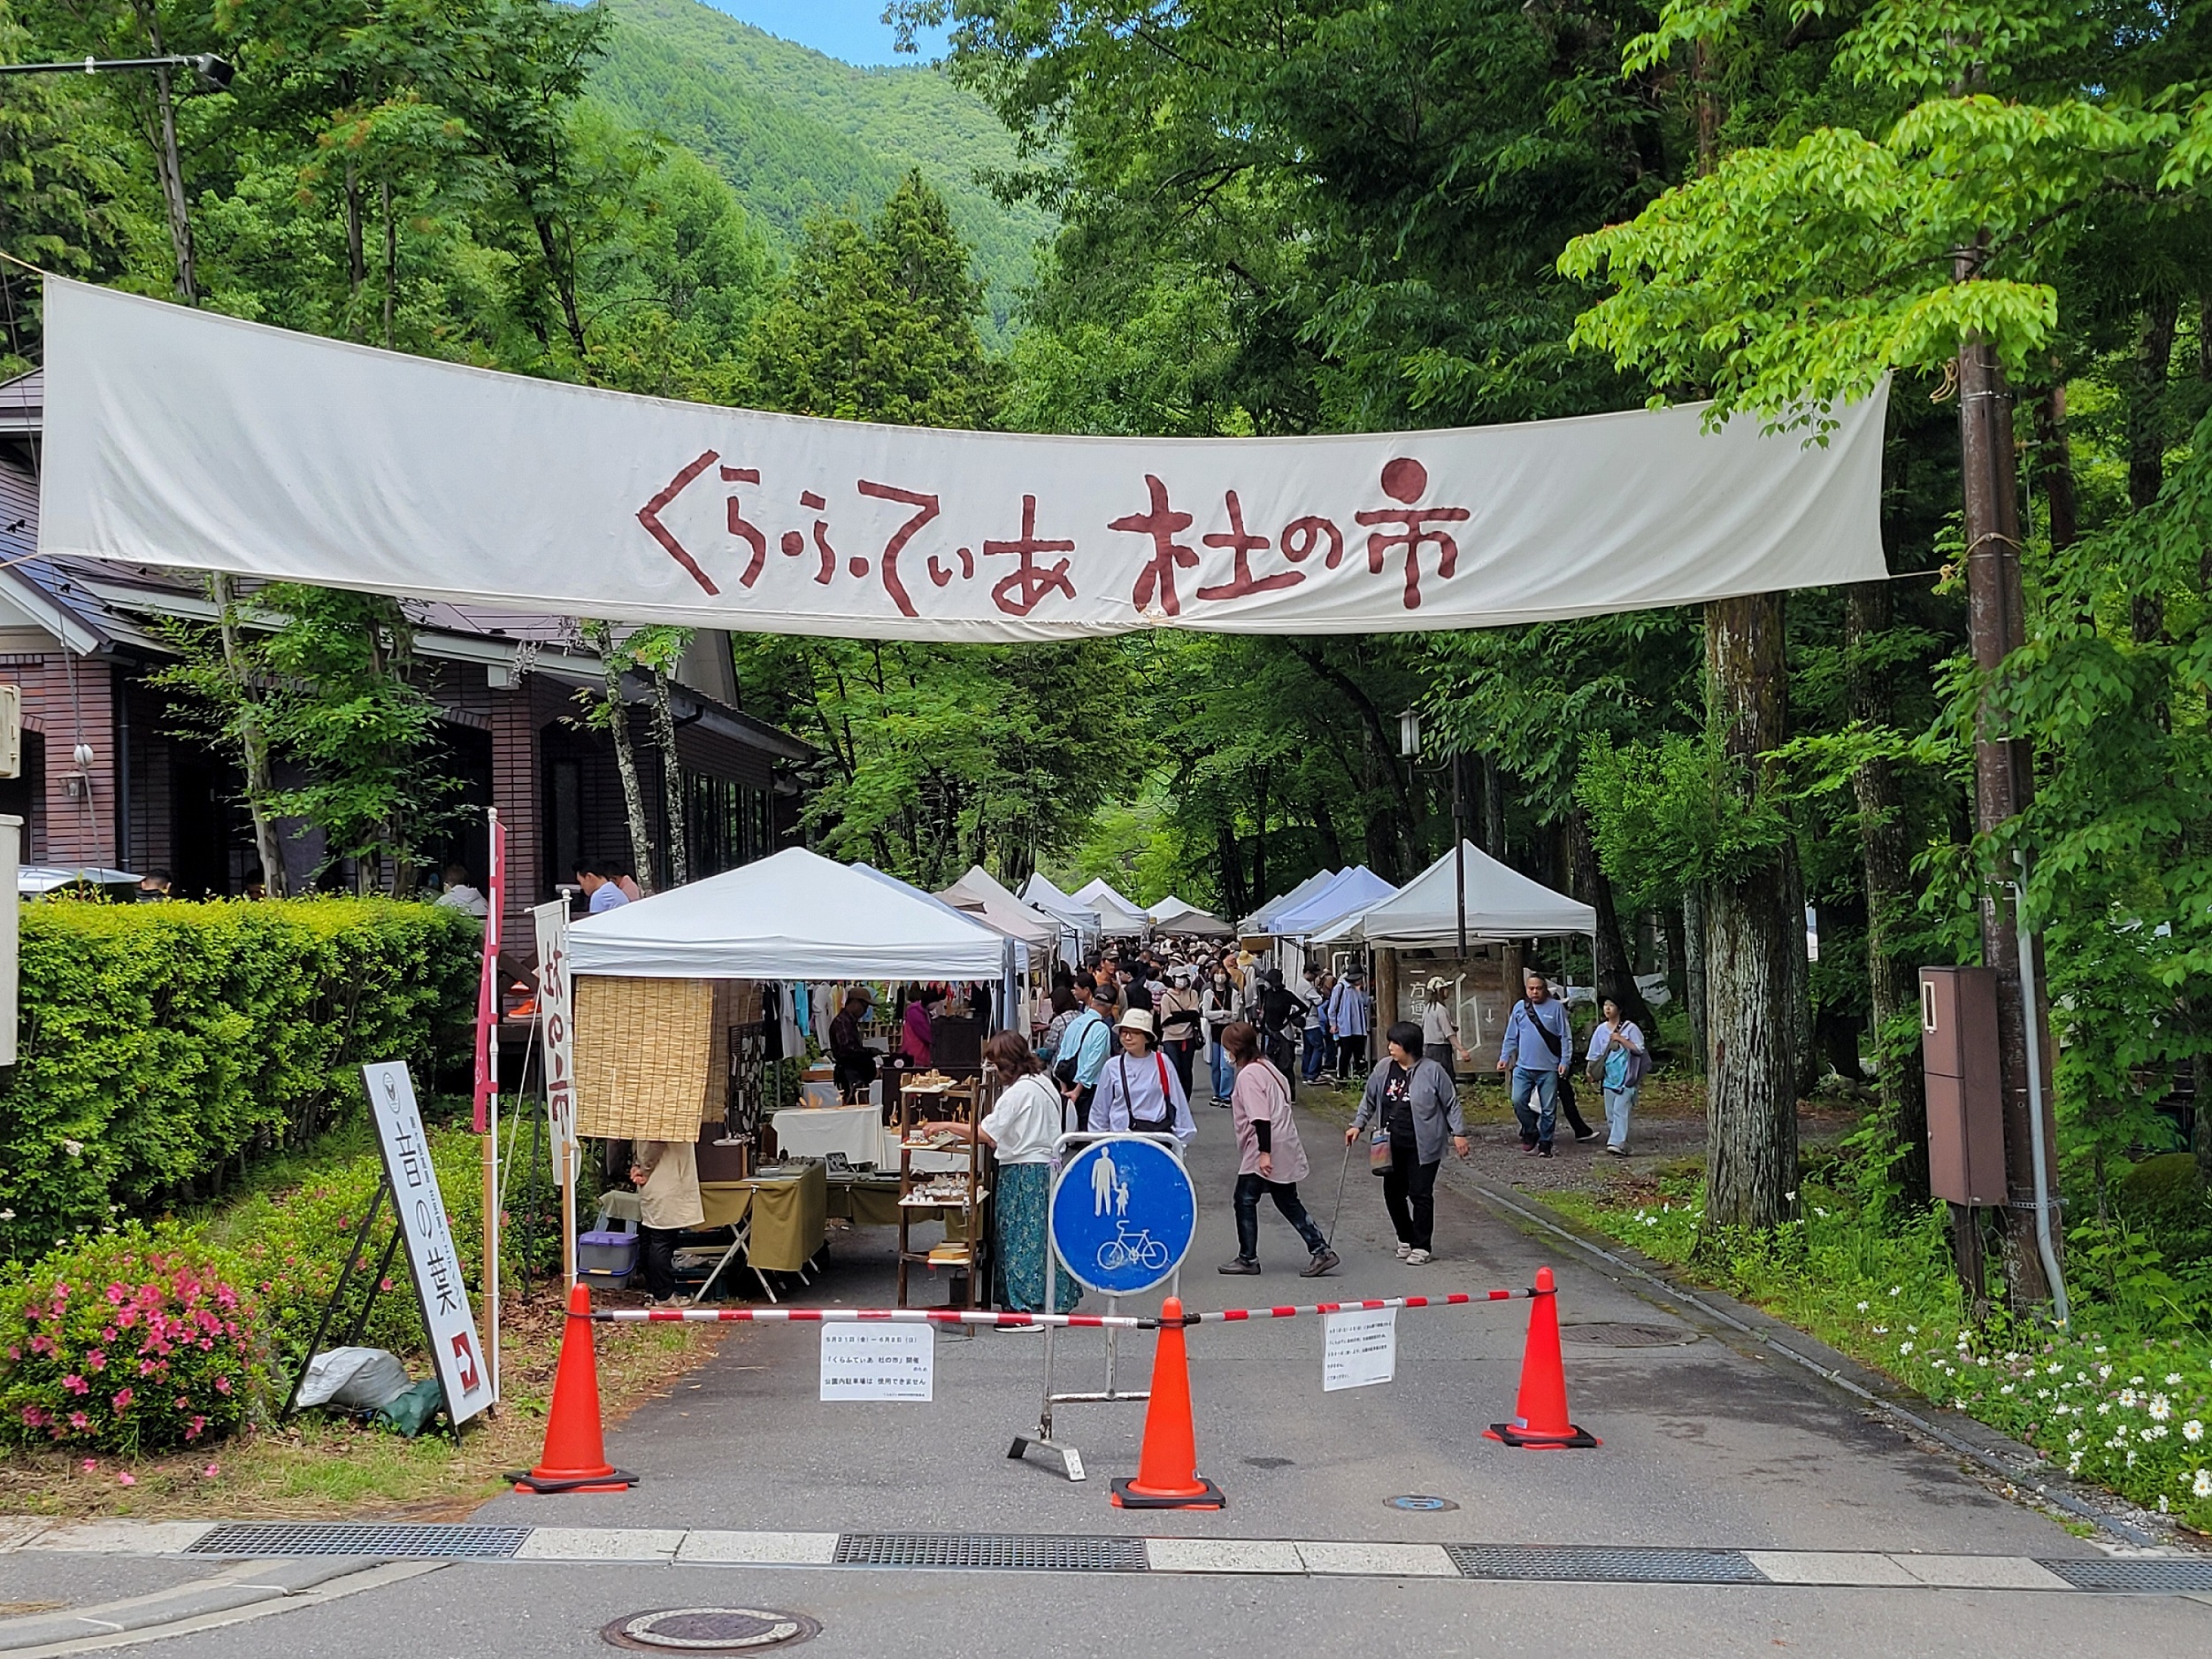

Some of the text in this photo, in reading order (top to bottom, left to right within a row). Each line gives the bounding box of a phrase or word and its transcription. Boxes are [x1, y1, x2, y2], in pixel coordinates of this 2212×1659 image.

[1108, 457, 1471, 617] 杜の市
[1409, 970, 1426, 1024] 一方通
